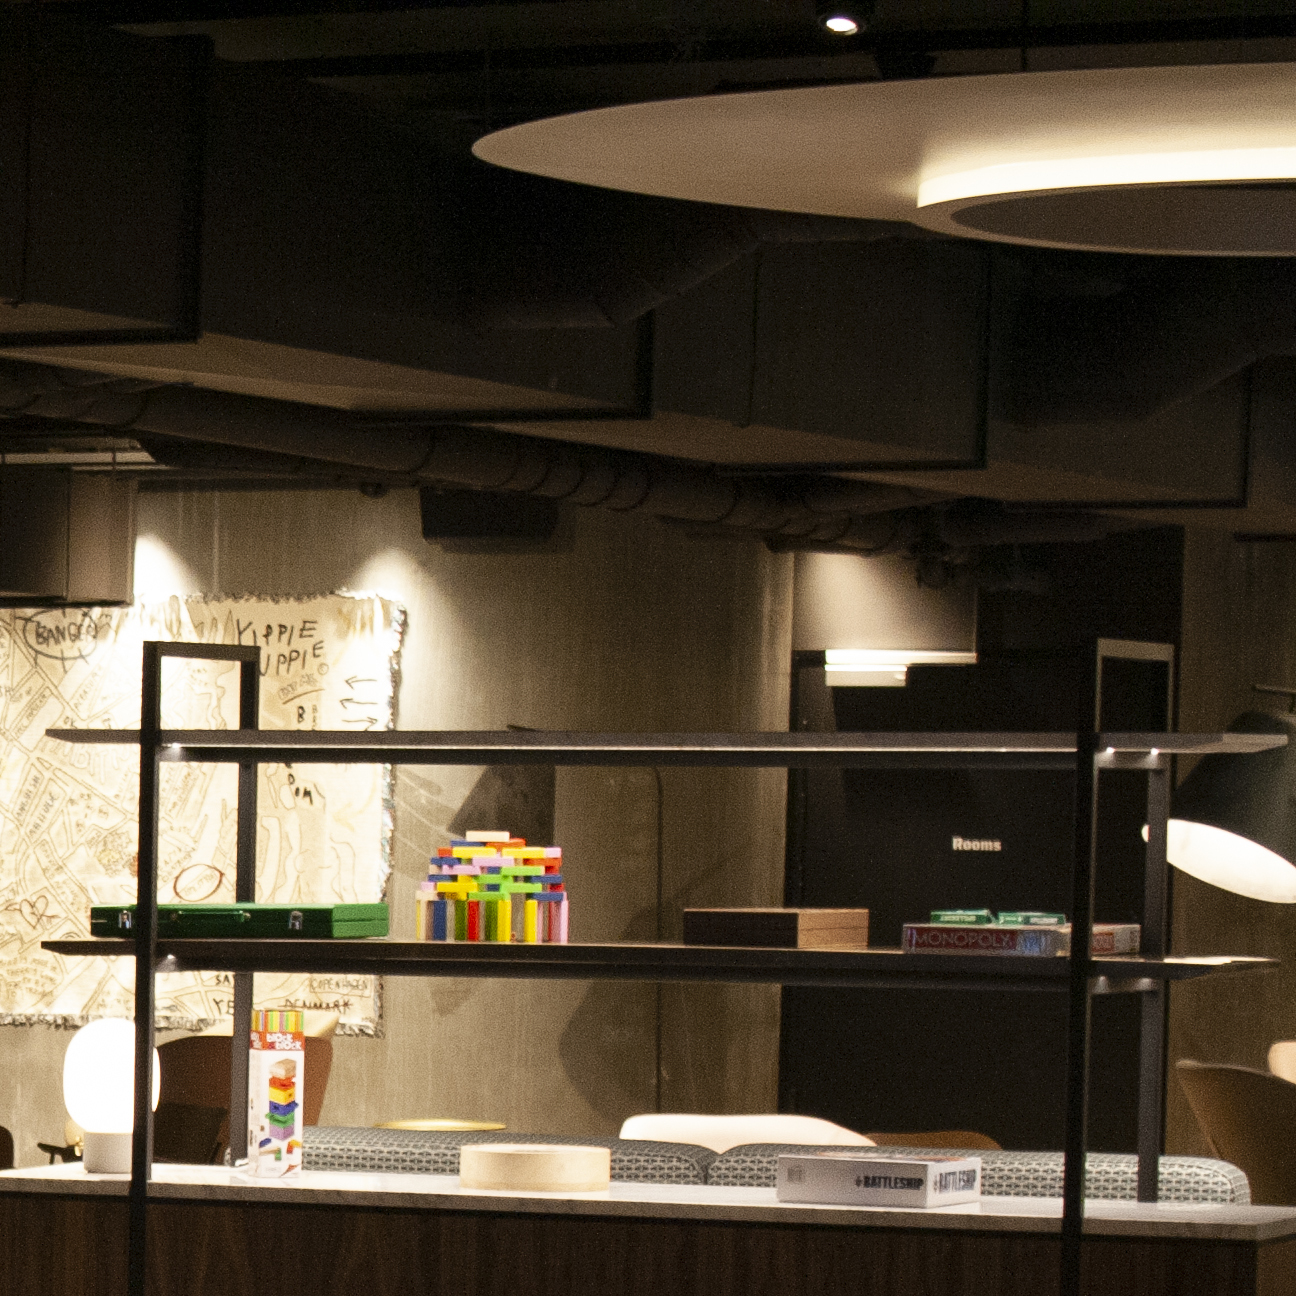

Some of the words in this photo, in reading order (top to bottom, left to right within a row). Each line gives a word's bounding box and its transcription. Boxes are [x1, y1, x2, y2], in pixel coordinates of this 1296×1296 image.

[236, 618, 317, 646] YIPPIE
[259, 640, 324, 676] UPPIE
[952, 834, 1002, 851] Rooms
[915, 930, 1013, 949] MONOPOLY
[863, 1175, 925, 1191] BATTLESHIP
[939, 1169, 977, 1194] BATTLESHIP
